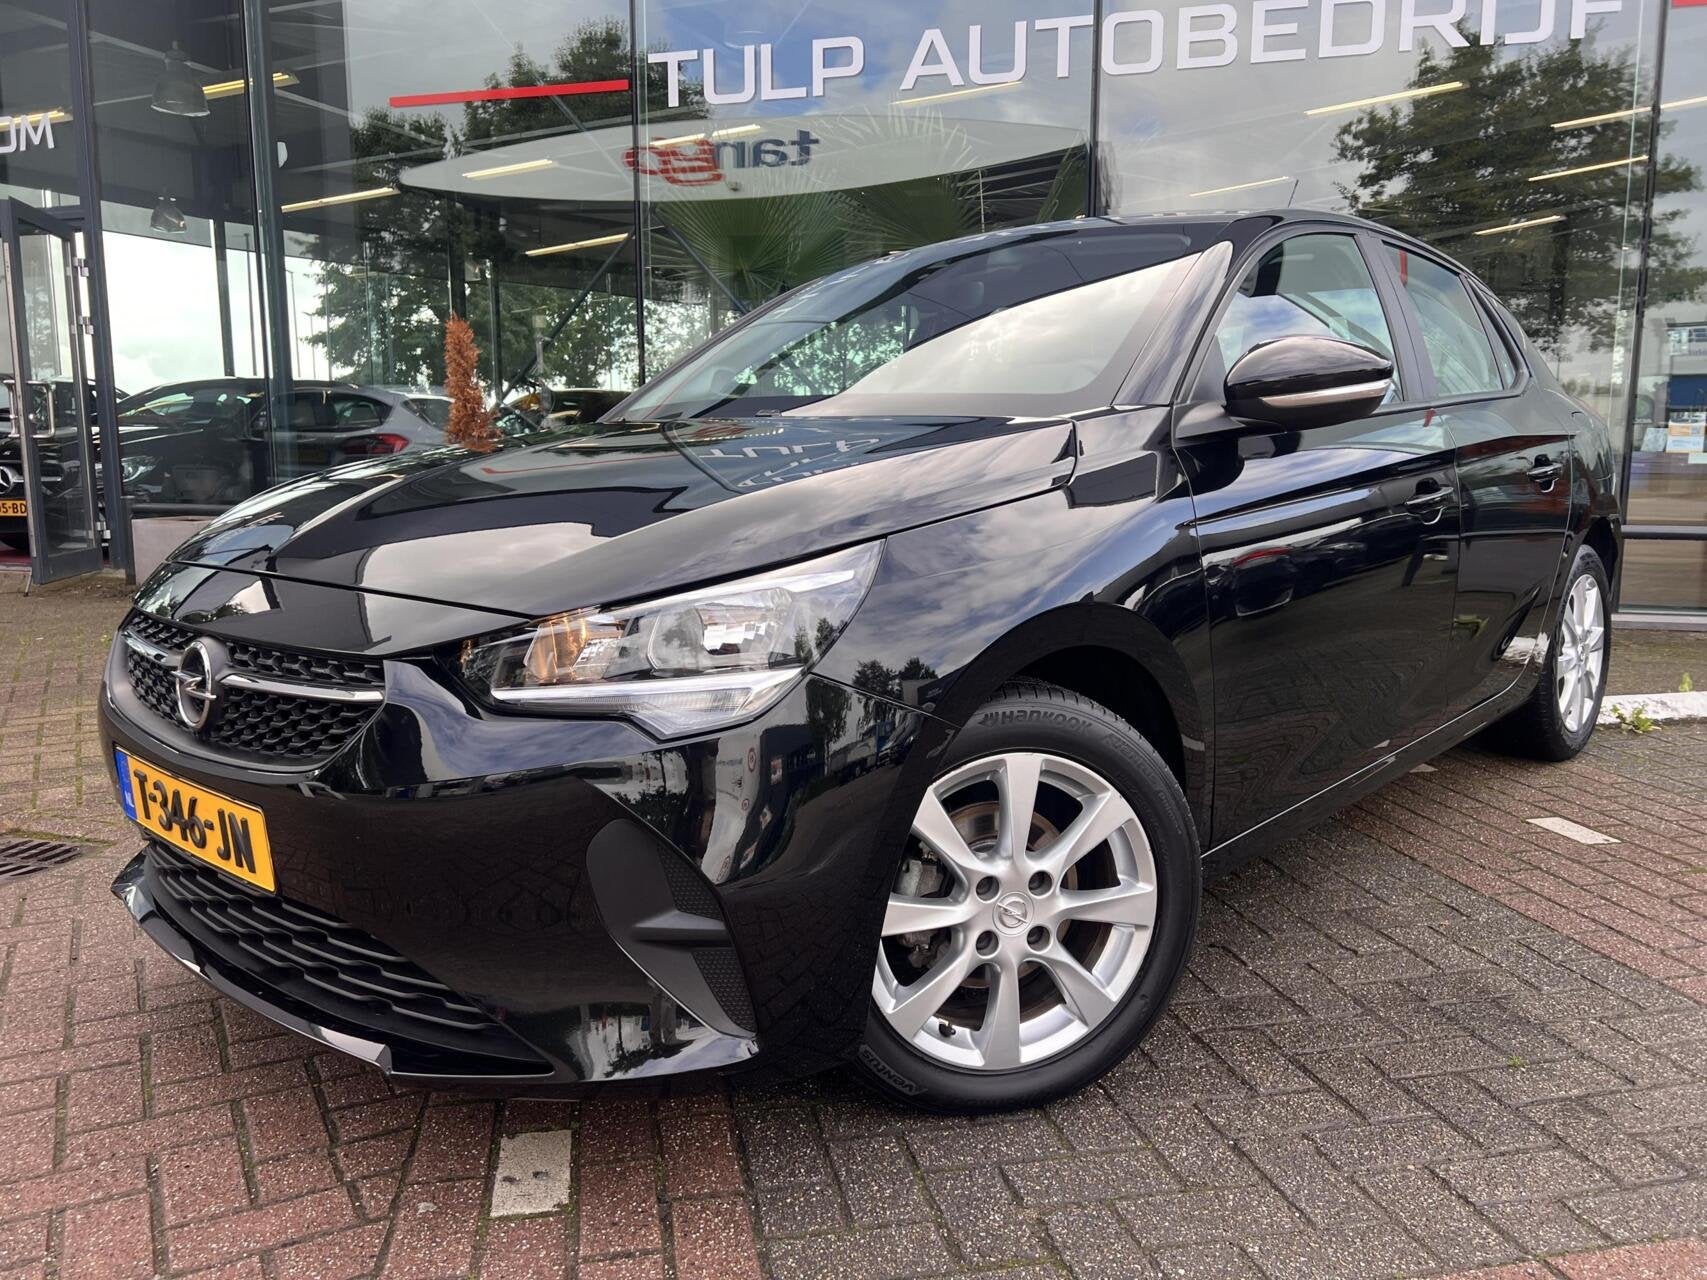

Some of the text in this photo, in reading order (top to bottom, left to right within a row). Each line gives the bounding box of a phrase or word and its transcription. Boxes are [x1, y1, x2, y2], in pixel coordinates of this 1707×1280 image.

[647, 0, 1623, 109] TULP AUTOBEDRIJF
[0, 502, 27, 514] 5-BD
[133, 769, 257, 874] T-346-JN
